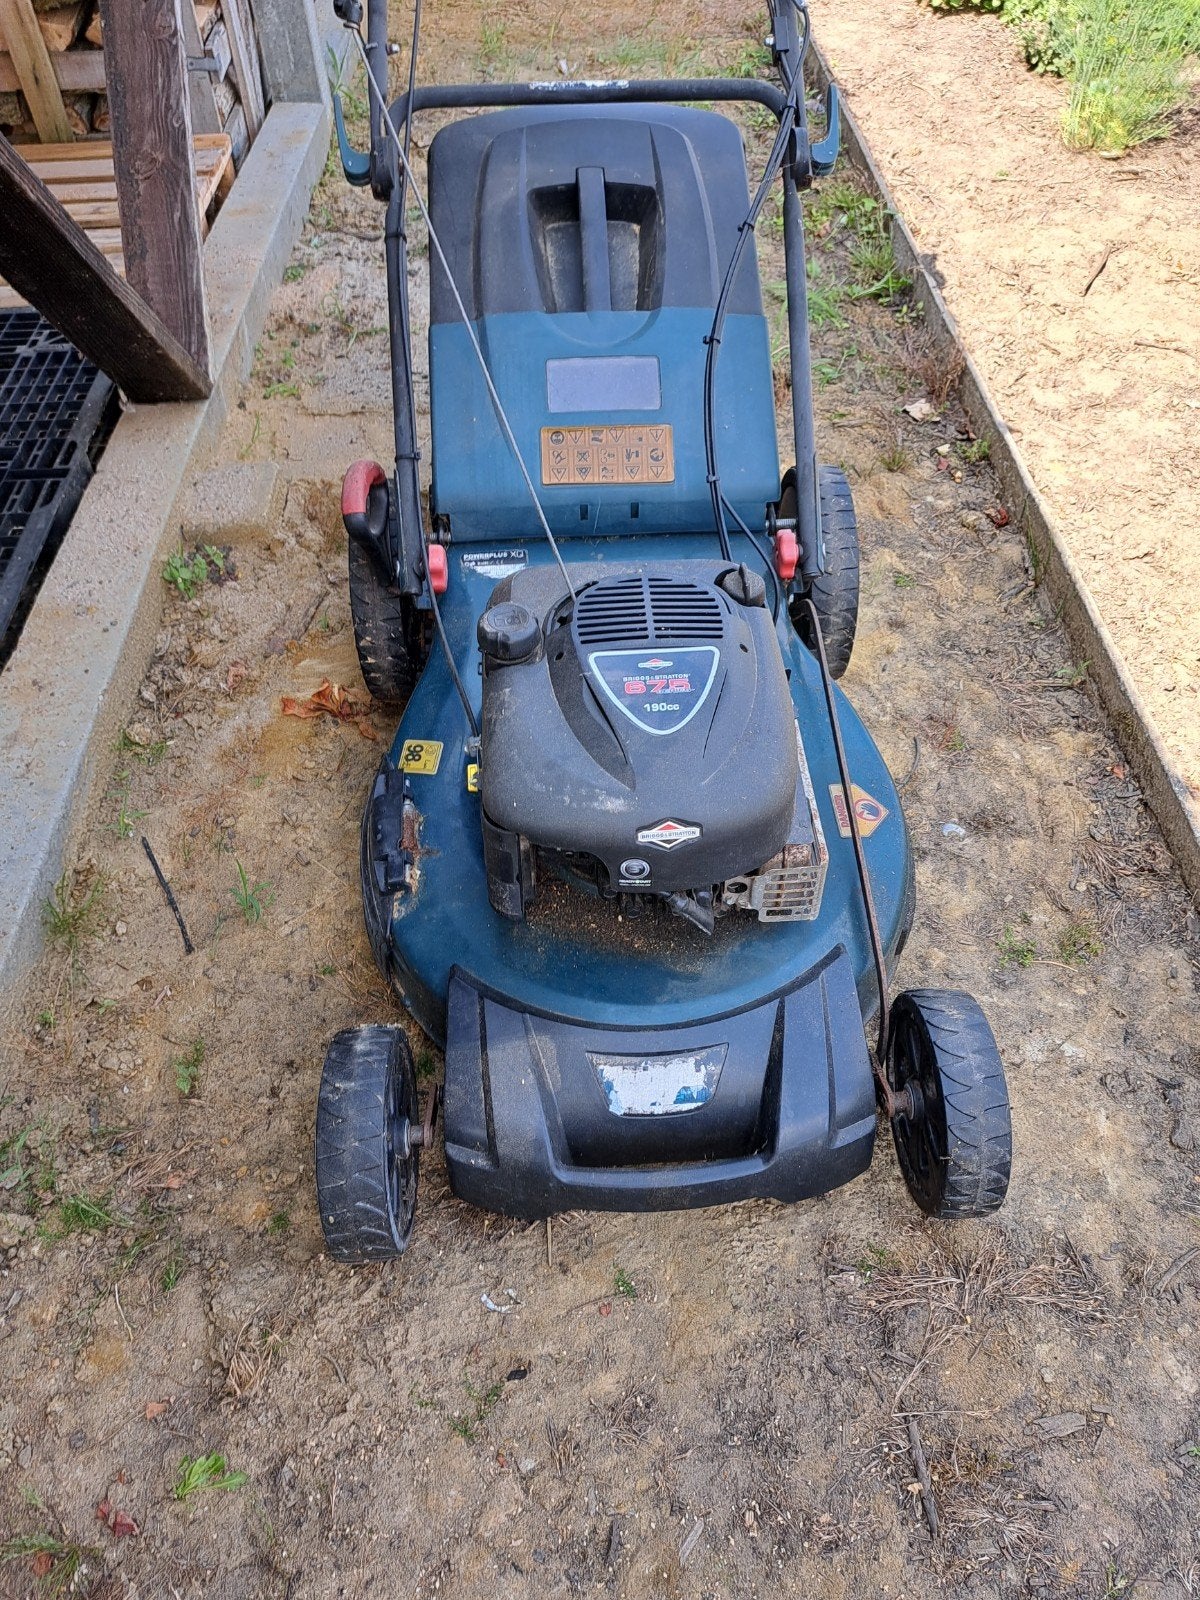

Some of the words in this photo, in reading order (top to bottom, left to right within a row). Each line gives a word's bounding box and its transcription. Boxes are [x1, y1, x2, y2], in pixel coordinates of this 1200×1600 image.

[463, 552, 507, 561] POWERPLUS
[624, 679, 691, 694] 675
[643, 702, 680, 712] 190cc
[405, 745, 424, 762] 98
[834, 794, 850, 828] DANGER
